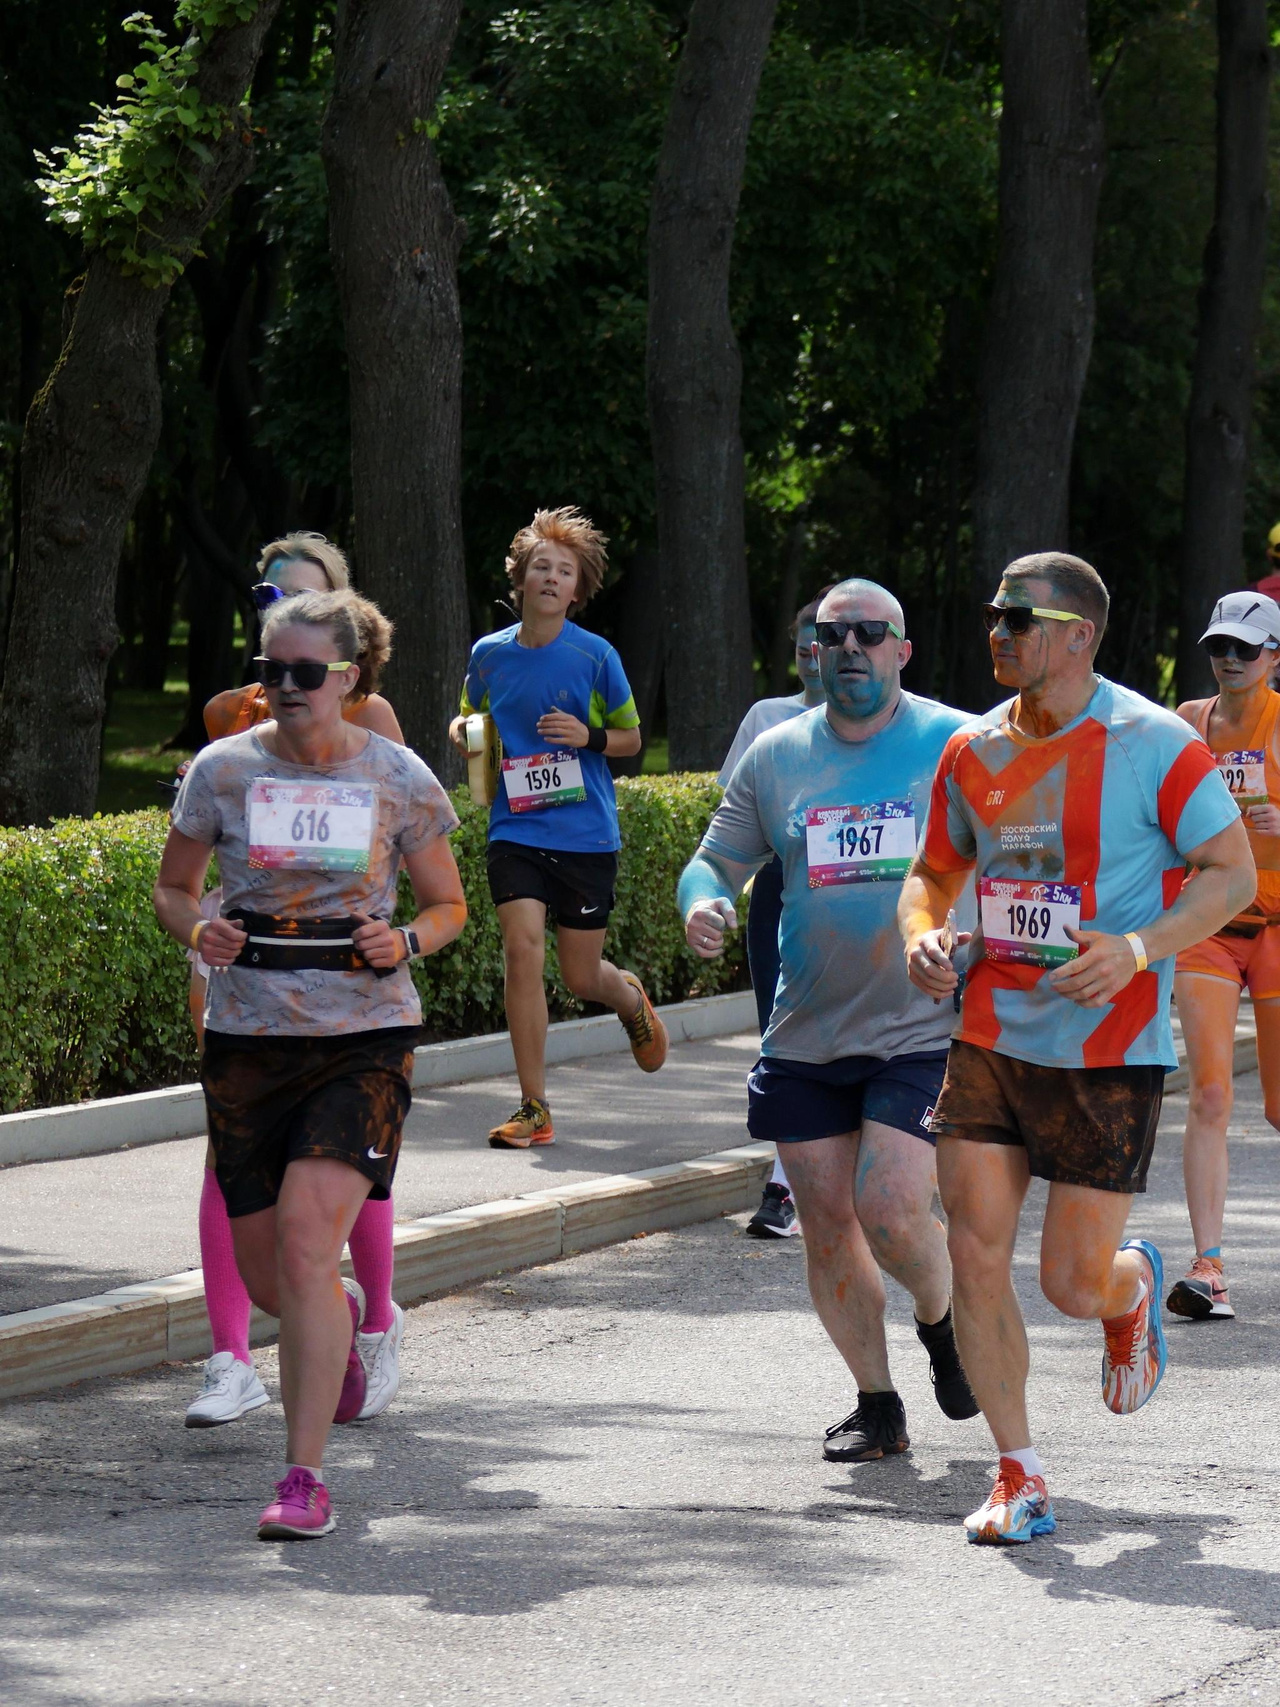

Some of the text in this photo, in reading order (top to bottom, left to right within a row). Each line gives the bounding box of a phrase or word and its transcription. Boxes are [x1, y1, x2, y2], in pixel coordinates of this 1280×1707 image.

[525, 767, 562, 791] 1596
[291, 809, 331, 843] 616
[1000, 823, 1058, 834] МОСКОВСКИЙ
[836, 825, 885, 857] 1967
[1001, 834, 1024, 843] ПОЛУ
[1002, 841, 1044, 851] МАРАФОН
[1007, 904, 1051, 940] 1969
